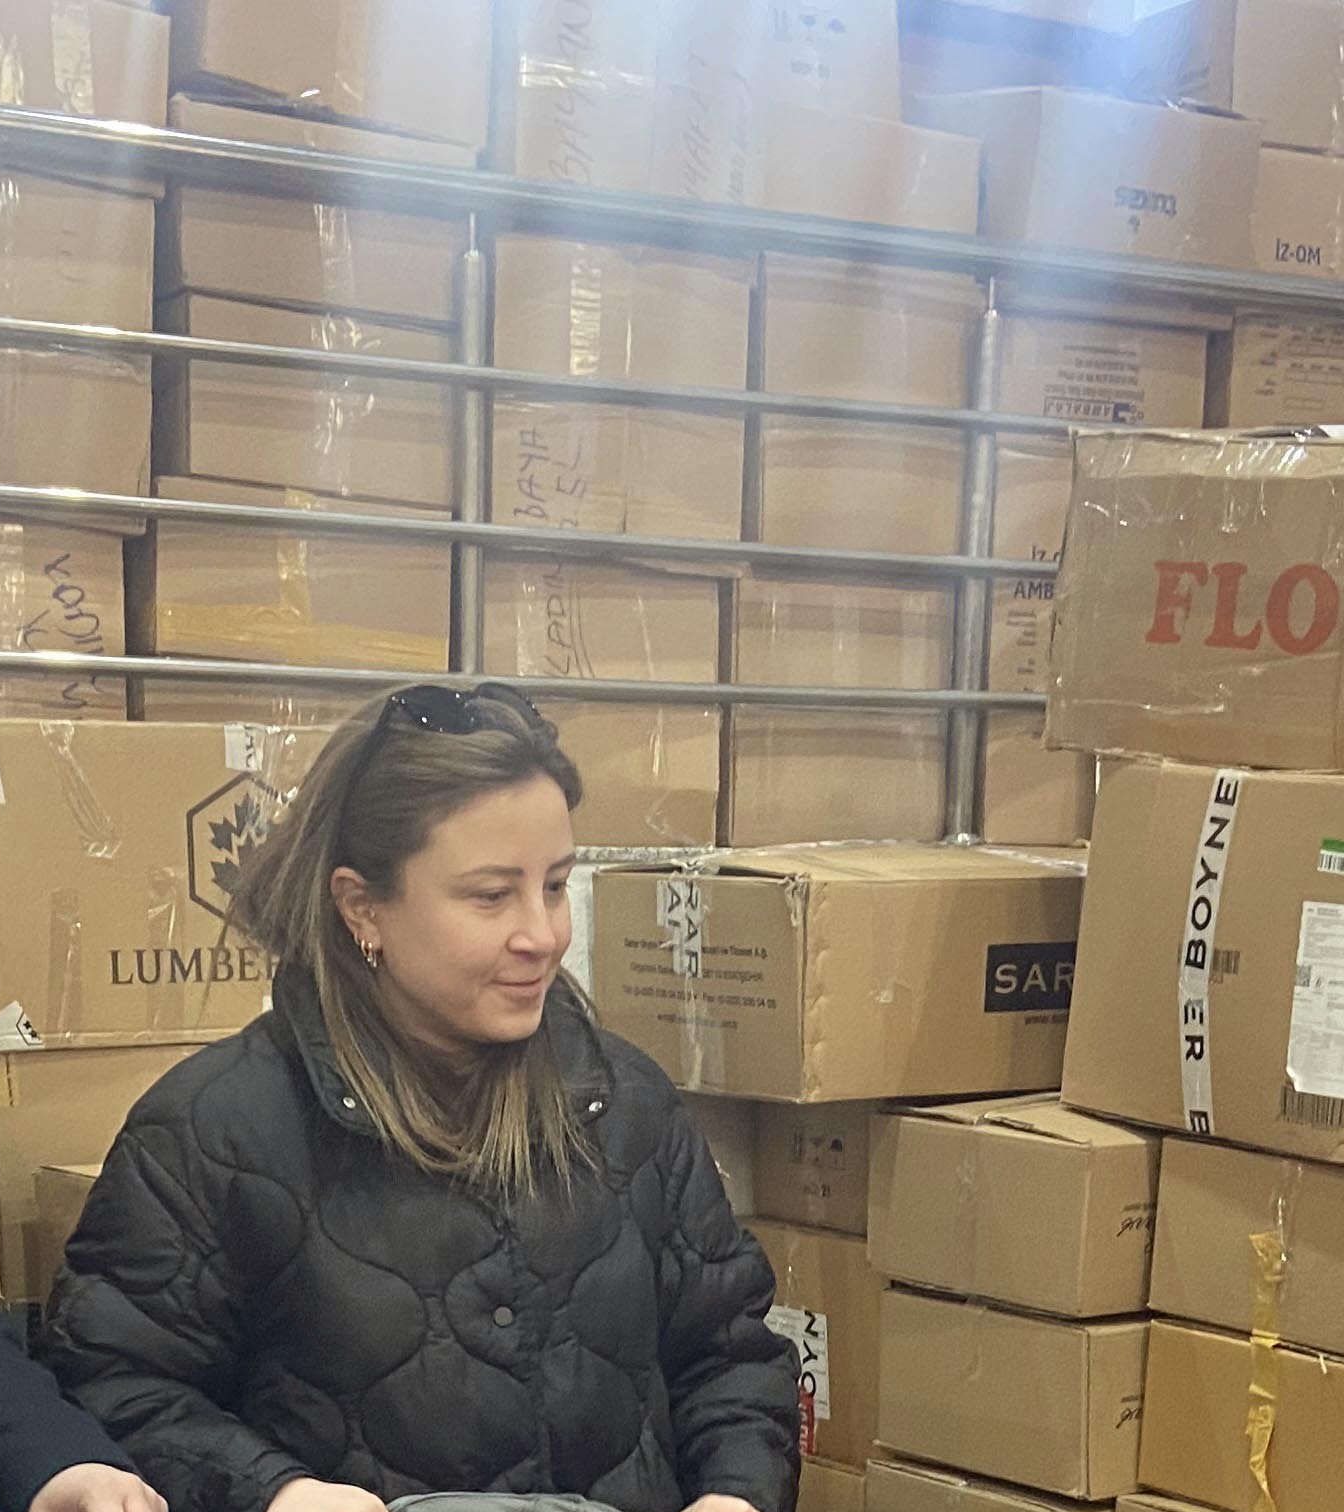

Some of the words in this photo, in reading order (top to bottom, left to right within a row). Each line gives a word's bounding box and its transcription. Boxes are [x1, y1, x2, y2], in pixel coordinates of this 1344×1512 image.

[1144, 559, 1341, 656] FLO
[108, 946, 278, 986] LUMBE
[993, 961, 1074, 994] SAR
[800, 1309, 819, 1397] OYN
